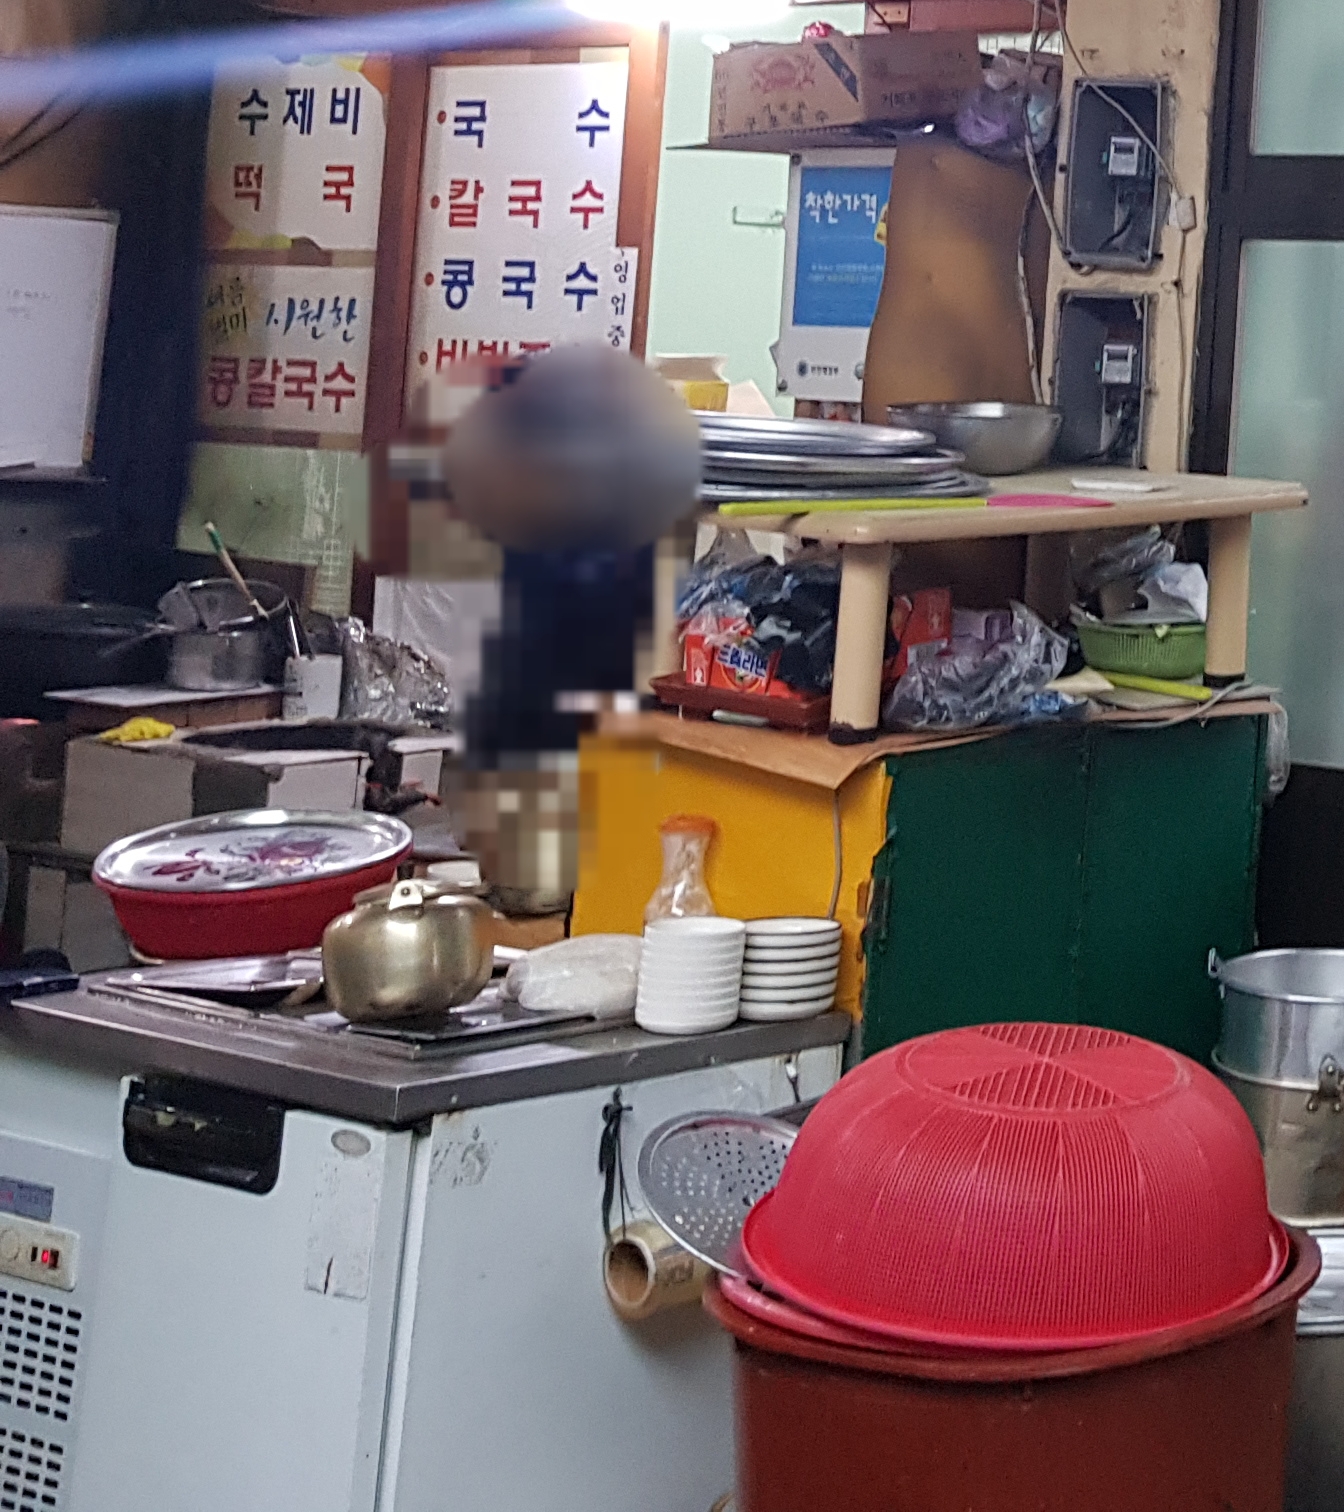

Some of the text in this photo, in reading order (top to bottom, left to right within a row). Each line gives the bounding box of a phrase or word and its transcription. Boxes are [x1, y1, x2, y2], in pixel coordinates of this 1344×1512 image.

[238, 87, 361, 136] 수제비
[805, 191, 877, 224] 착한가격
[265, 295, 357, 343] 시원한
[208, 356, 356, 414] 콩칼국수
